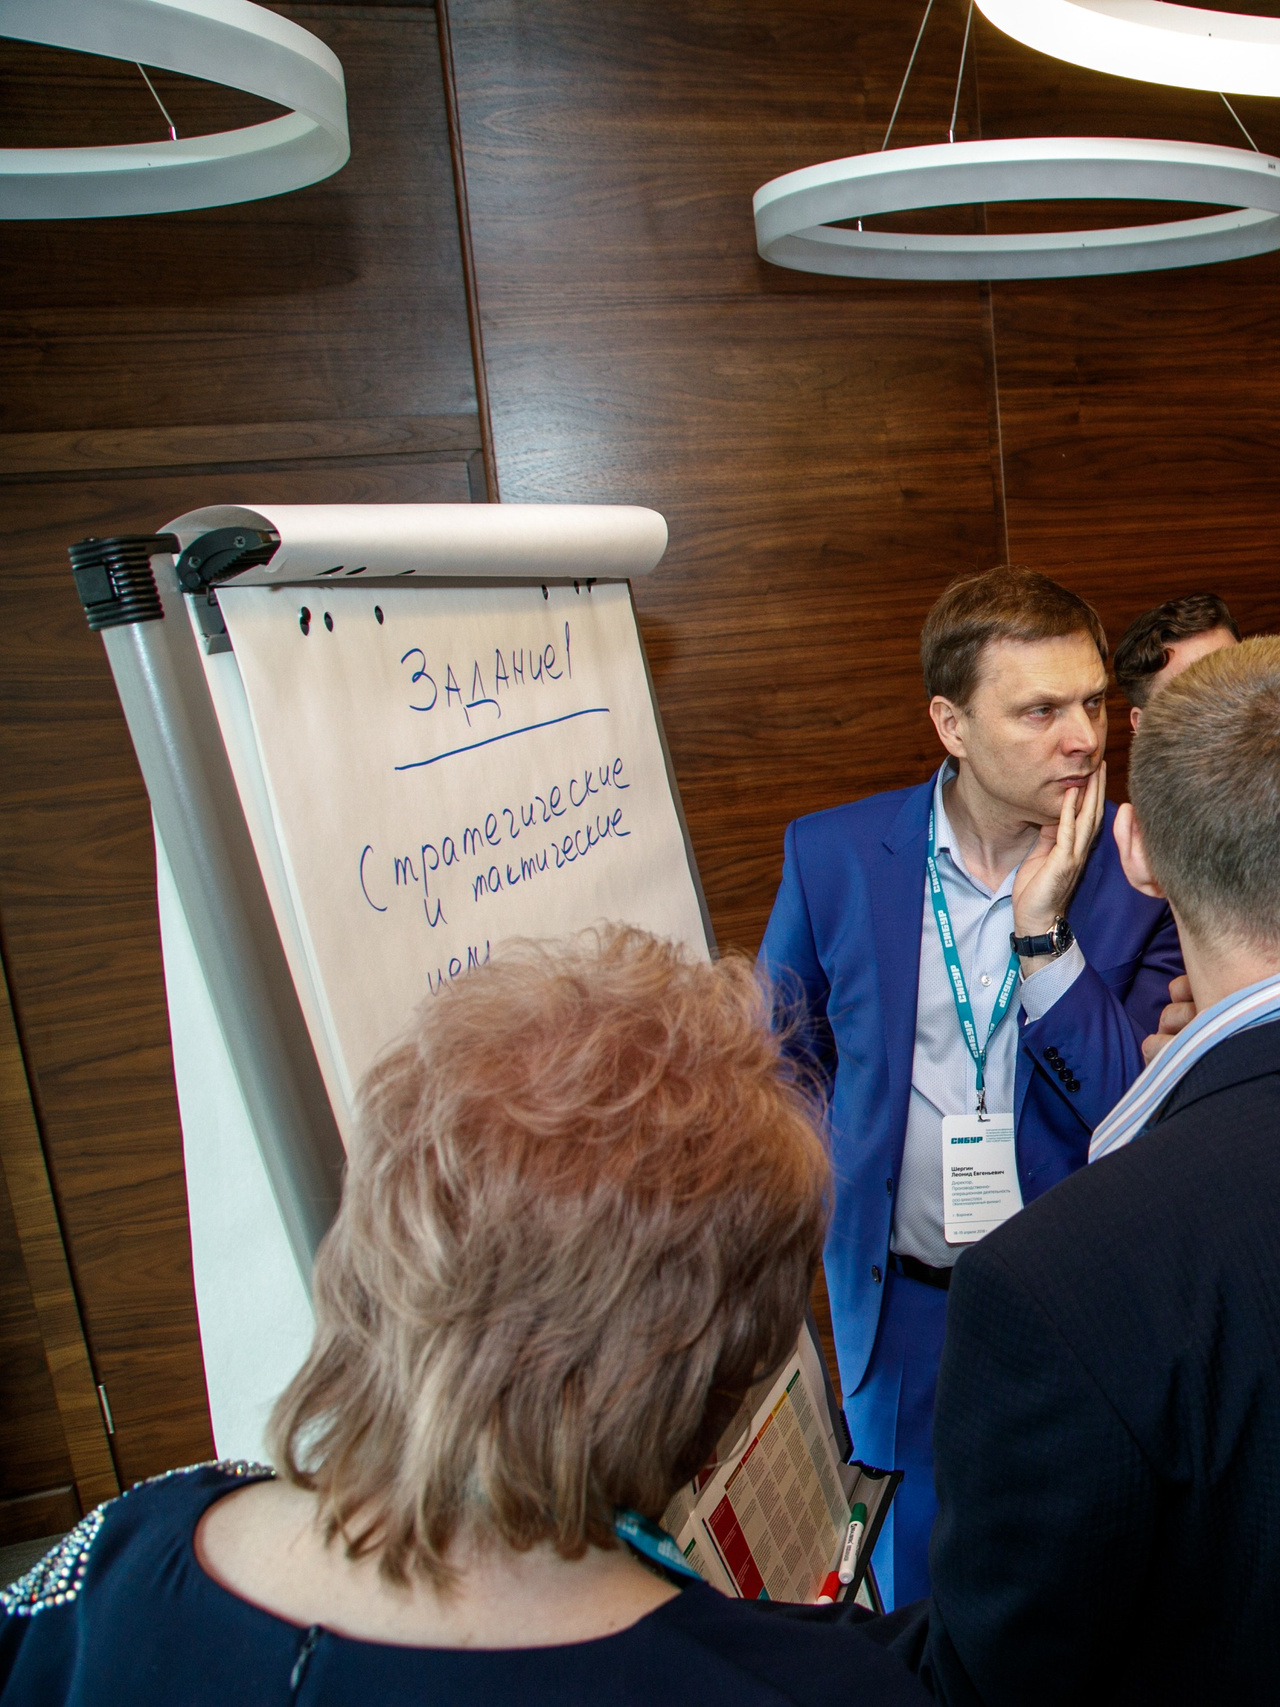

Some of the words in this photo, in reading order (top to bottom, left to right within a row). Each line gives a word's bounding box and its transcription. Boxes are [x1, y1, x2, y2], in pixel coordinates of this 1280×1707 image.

[471, 807, 632, 903] тактические
[927, 856, 941, 893] СИБУР
[938, 909, 954, 948] СИБУР
[949, 964, 967, 1003] СИБУР
[998, 969, 1017, 1008] СИБУР
[963, 1020, 980, 1059] СИБУР
[951, 1136, 983, 1144] СИБУР
